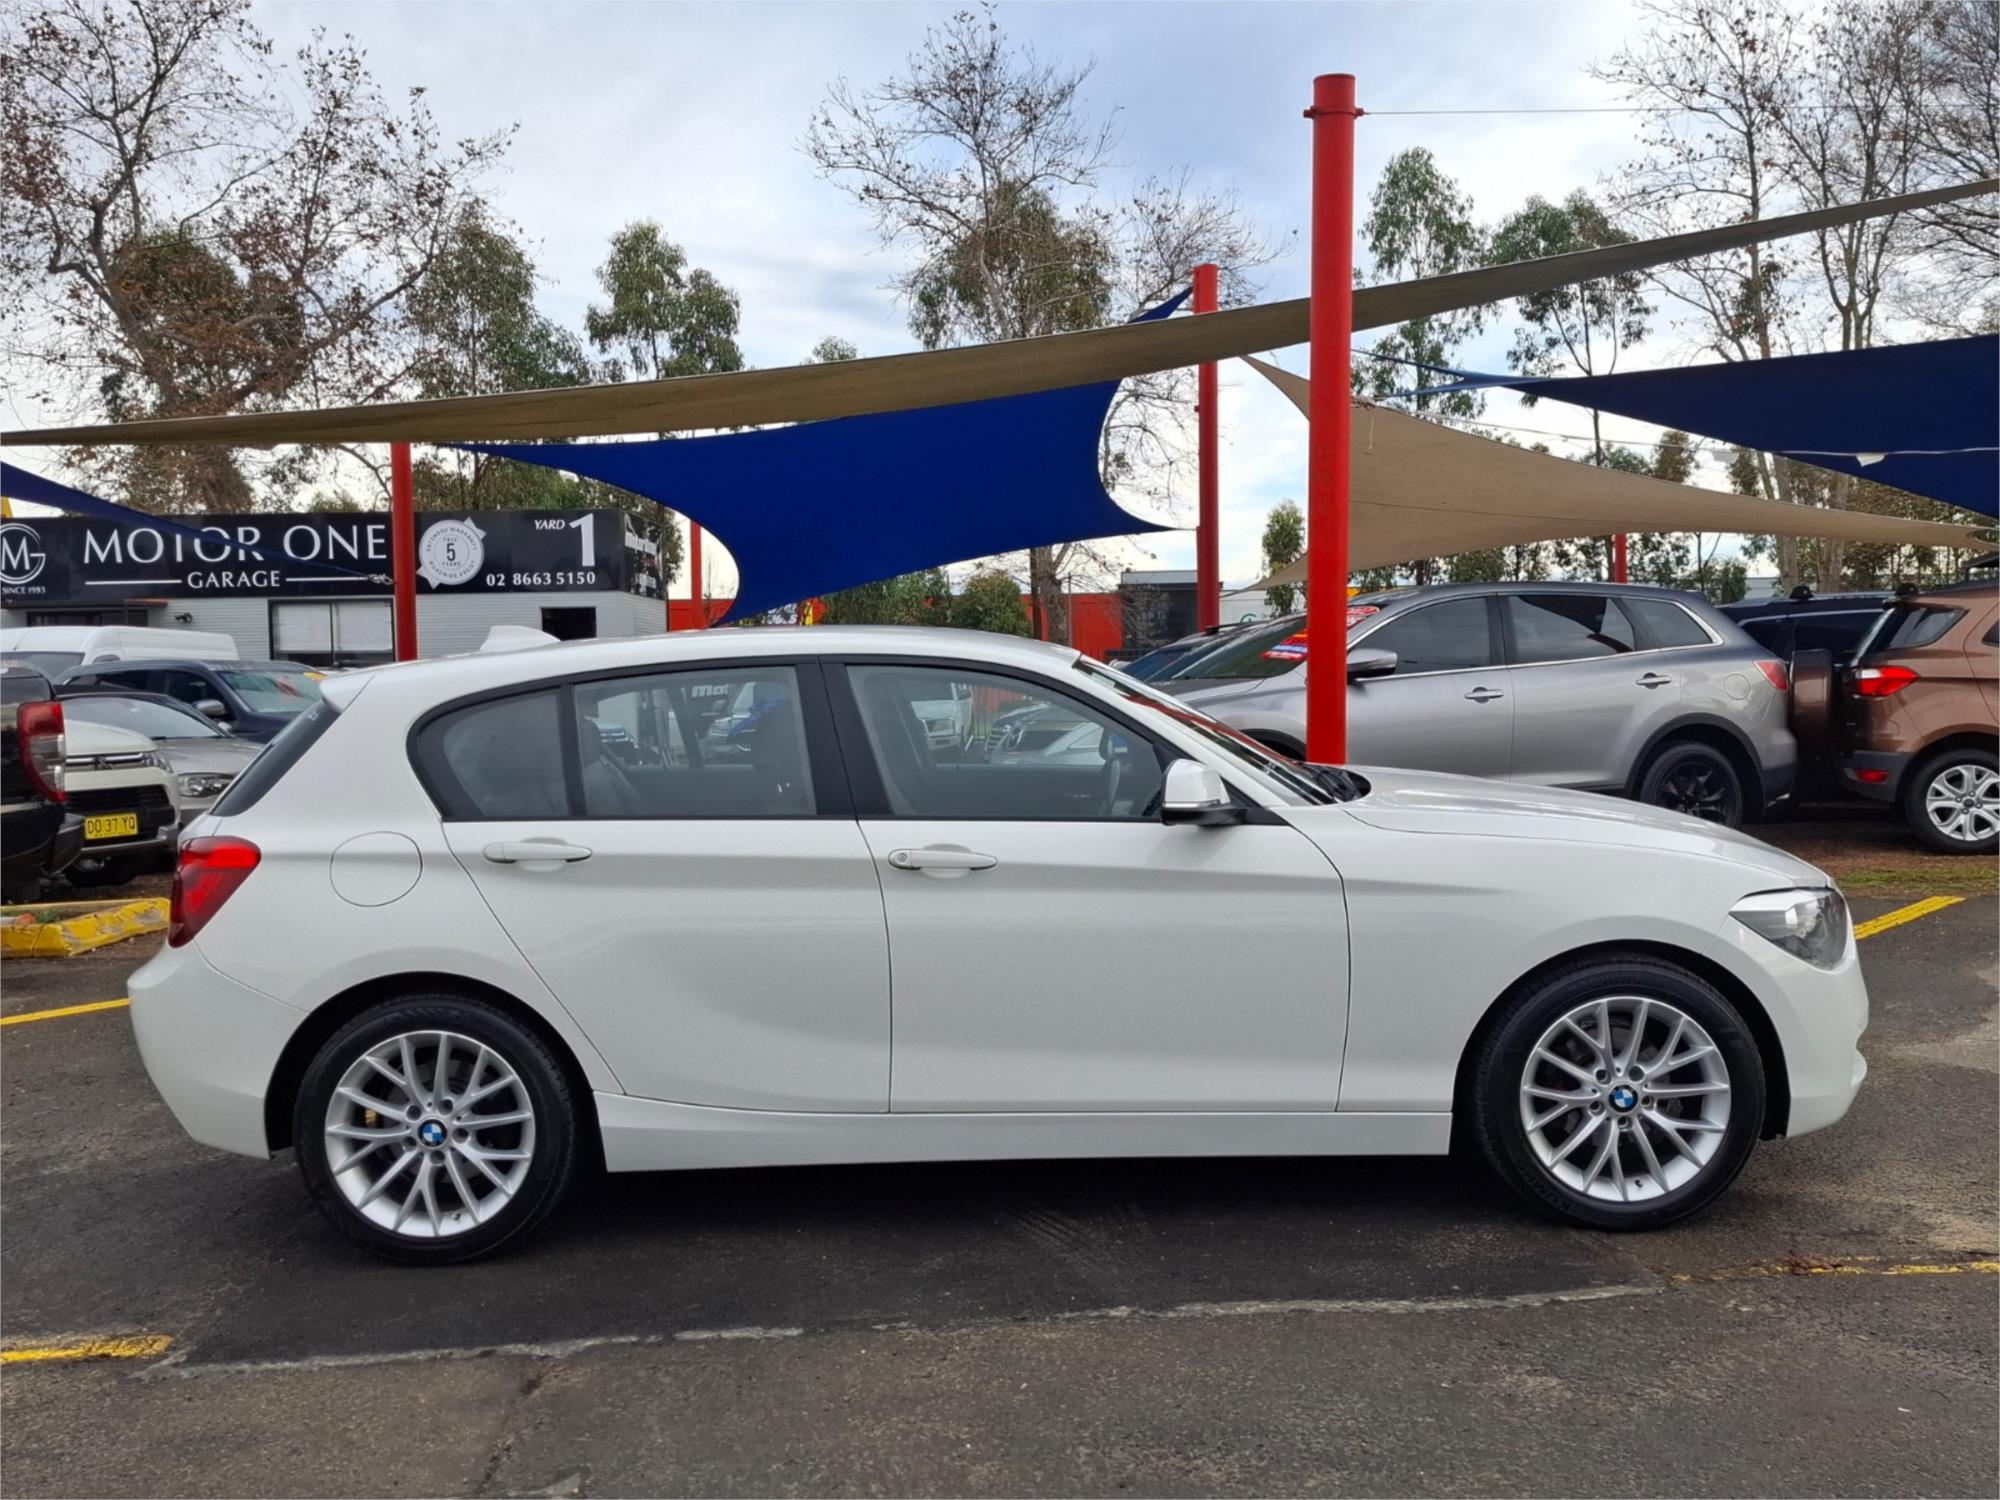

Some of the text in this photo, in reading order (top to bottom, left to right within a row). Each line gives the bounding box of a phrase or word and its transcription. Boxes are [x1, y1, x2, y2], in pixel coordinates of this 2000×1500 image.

[84, 524, 387, 564] MOTOR ONE
[534, 519, 566, 530] YARD
[569, 513, 595, 567] 1
[446, 542, 456, 562] 5
[187, 570, 280, 588] GARAGE
[486, 571, 596, 586] 02 8663 5150
[2, 586, 46, 595] SINCE 1993
